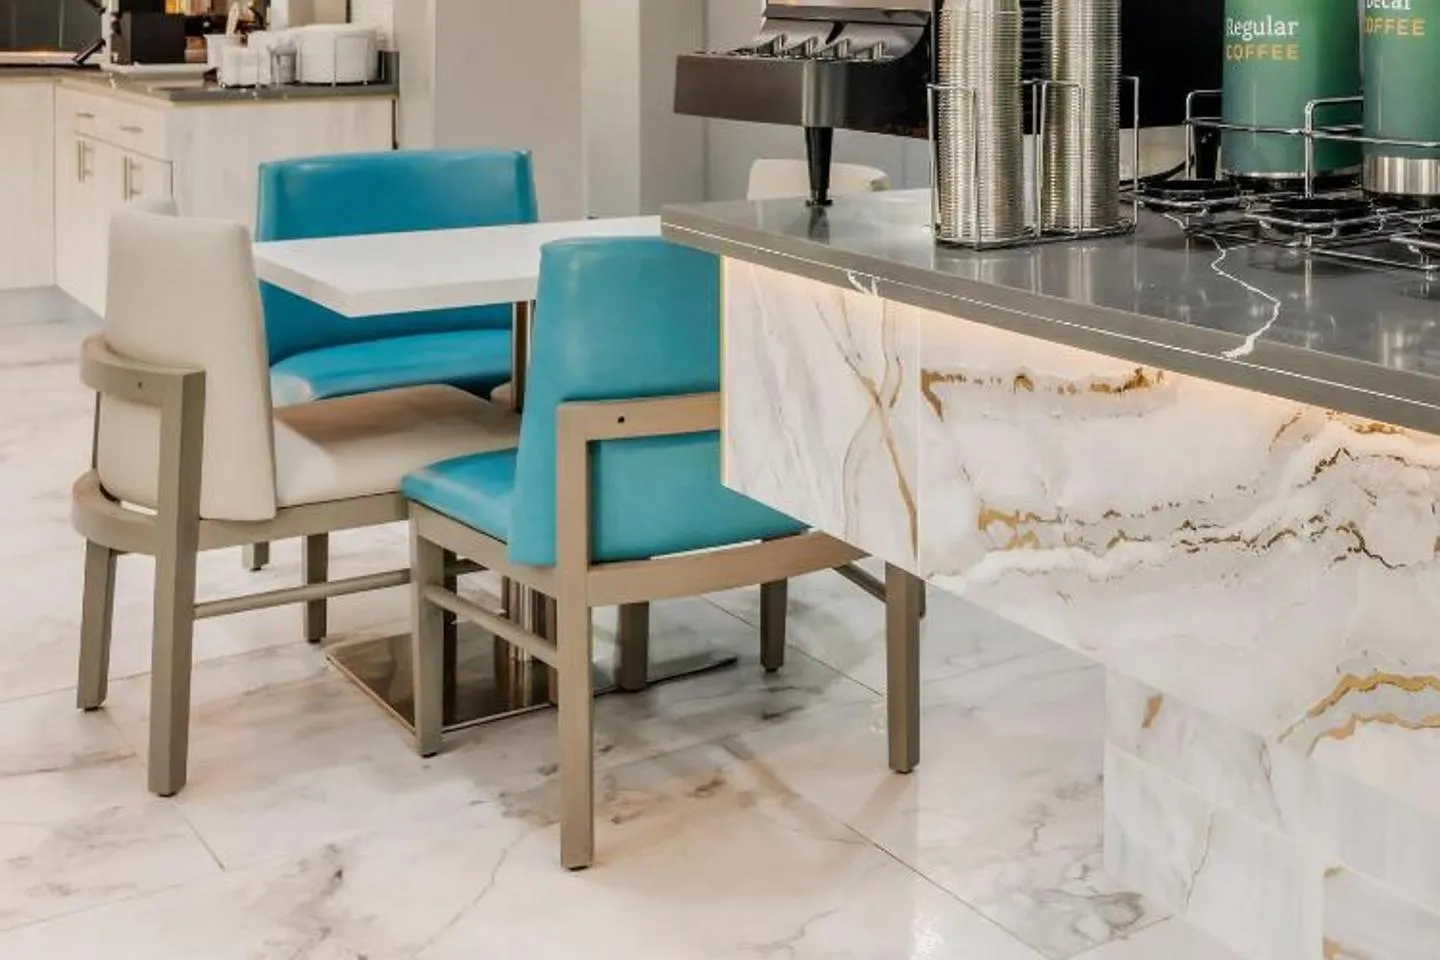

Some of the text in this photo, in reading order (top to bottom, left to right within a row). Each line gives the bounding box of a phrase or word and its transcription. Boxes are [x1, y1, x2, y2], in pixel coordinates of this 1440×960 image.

[1226, 14, 1299, 42] Regular
[1366, 16, 1427, 36] OFFEE
[1226, 43, 1299, 61] COFFEE
